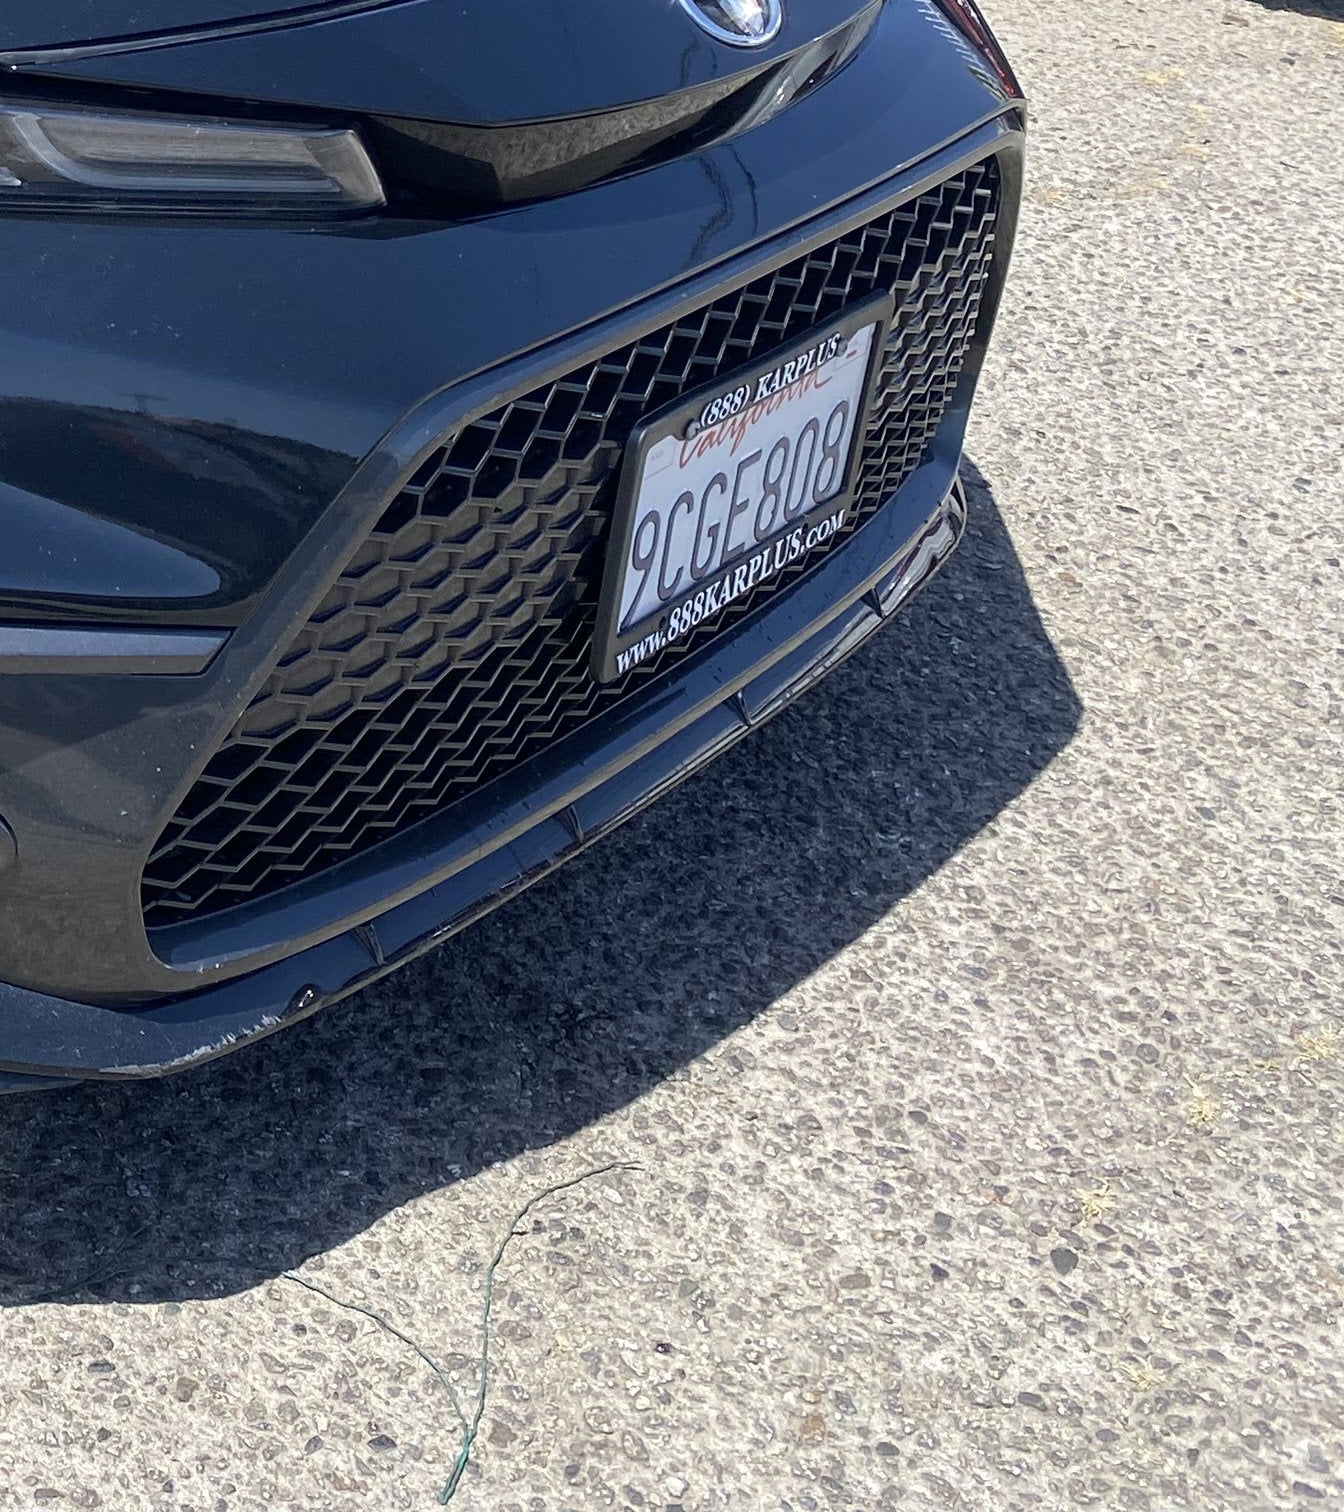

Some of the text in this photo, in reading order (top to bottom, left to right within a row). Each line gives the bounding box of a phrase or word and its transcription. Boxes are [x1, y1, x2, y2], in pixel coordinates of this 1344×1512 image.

[701, 333, 841, 428] (888) KARPLUS
[617, 399, 850, 636] 9CGE808
